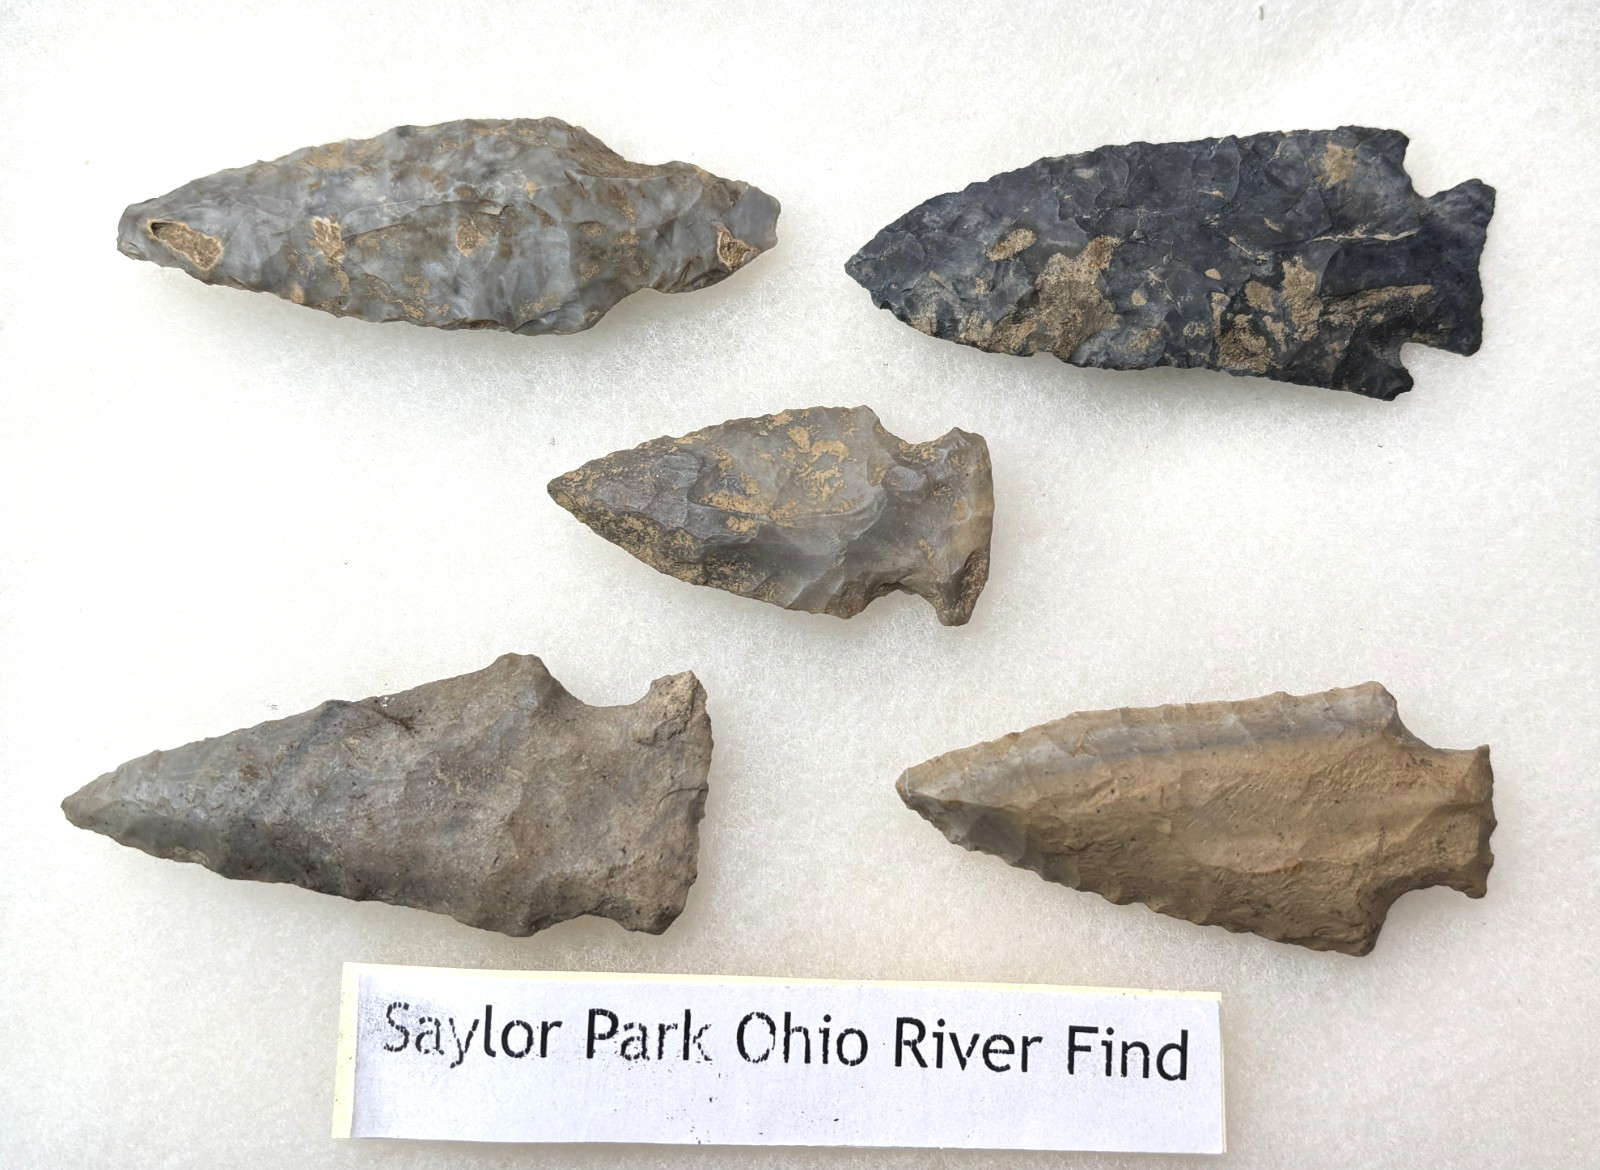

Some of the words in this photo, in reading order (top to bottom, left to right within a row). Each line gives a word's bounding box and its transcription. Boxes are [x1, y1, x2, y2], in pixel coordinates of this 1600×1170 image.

[384, 1001, 564, 1068] Saylor
[586, 1008, 712, 1063] Park
[736, 1011, 868, 1067] Ohio
[894, 1016, 1043, 1073] River
[1067, 1025, 1188, 1081] Find
